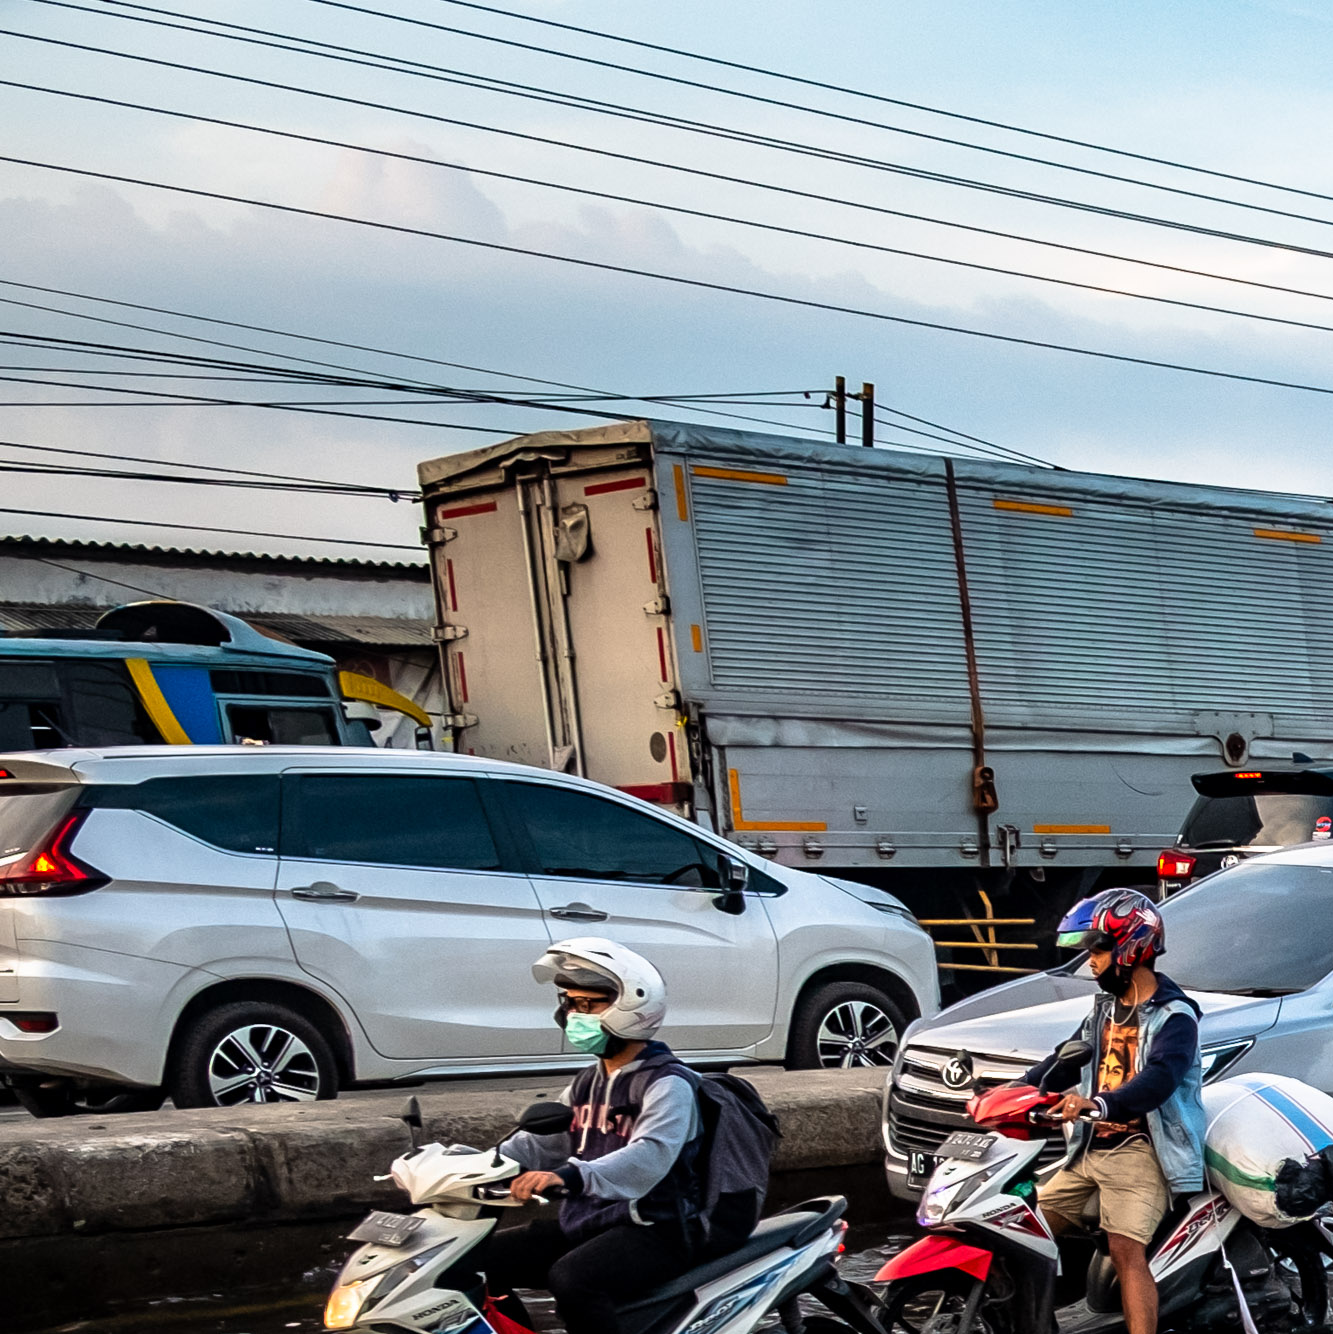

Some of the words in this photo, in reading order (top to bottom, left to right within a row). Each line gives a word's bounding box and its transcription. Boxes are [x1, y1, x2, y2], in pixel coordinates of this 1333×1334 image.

[911, 1152, 924, 1174] AG
[982, 1203, 1017, 1218] HONDA
[412, 1299, 460, 1320] HONDA
